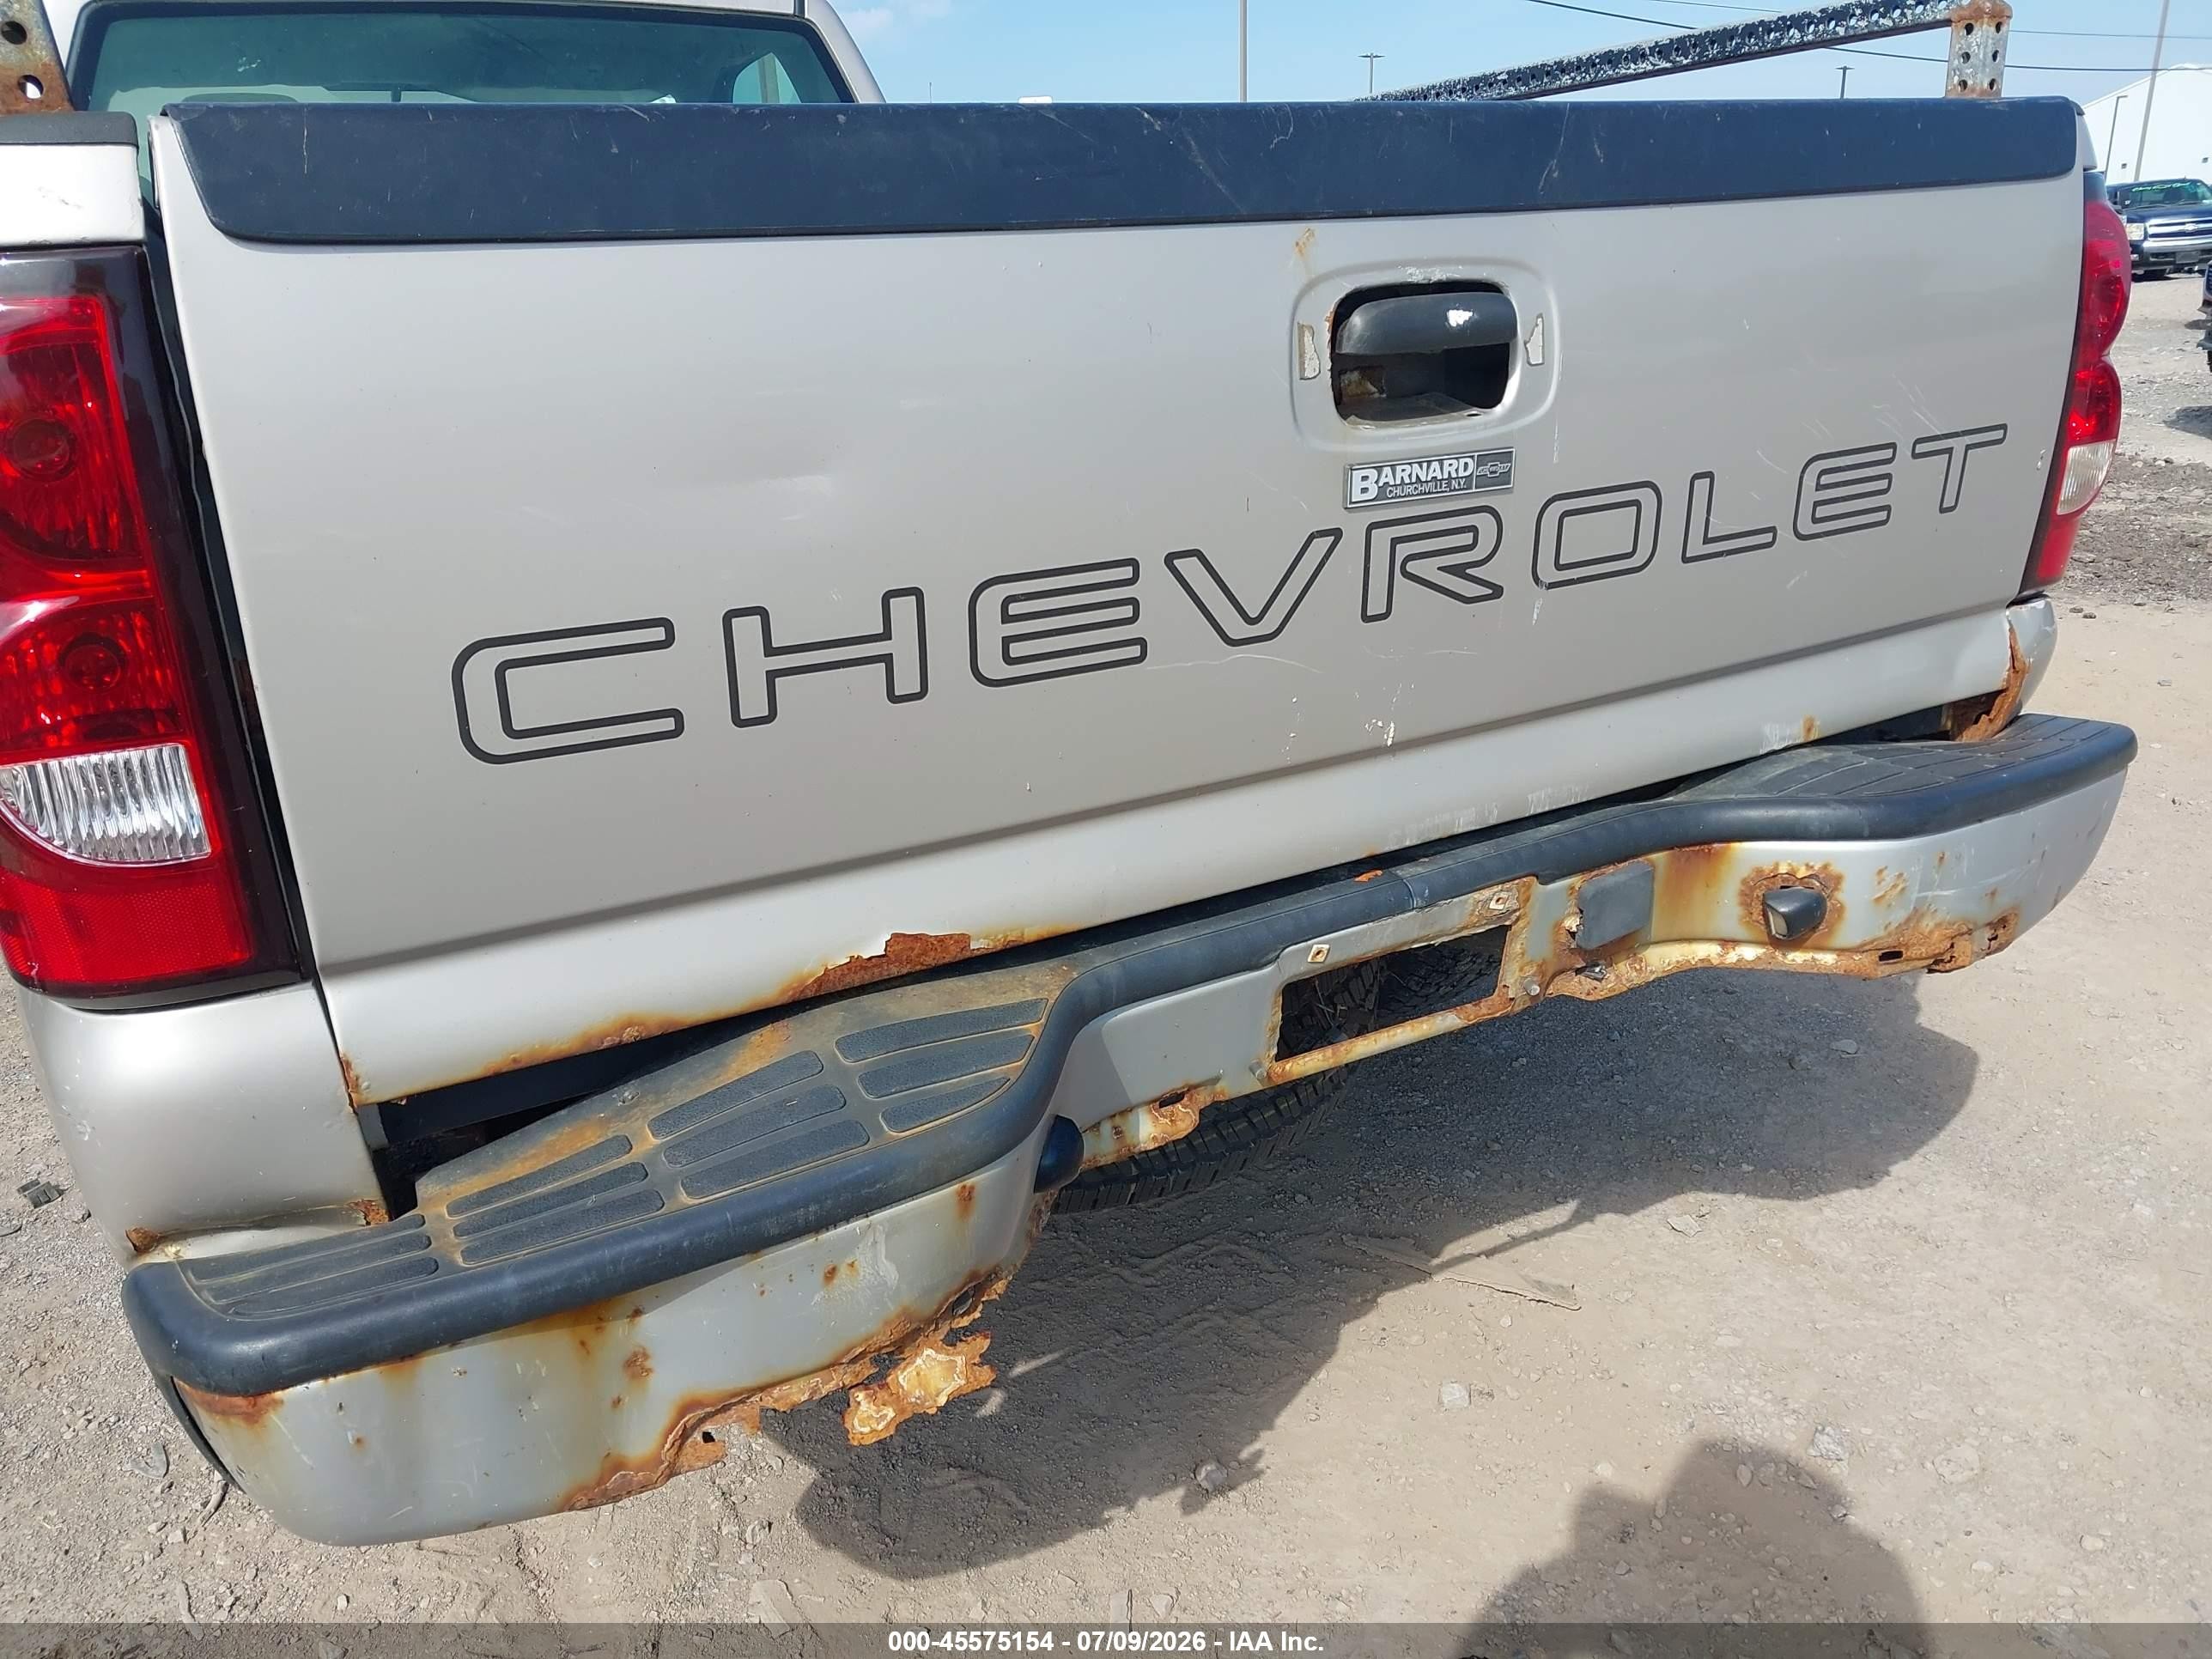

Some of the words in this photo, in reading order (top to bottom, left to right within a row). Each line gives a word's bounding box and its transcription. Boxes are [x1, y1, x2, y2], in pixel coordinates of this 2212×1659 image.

[1352, 458, 1474, 501] BARNARD
[1387, 483, 1449, 498] CHURCHVILLE,
[1451, 478, 1467, 489] N.Y.
[452, 423, 2008, 764] CHEVROLET
